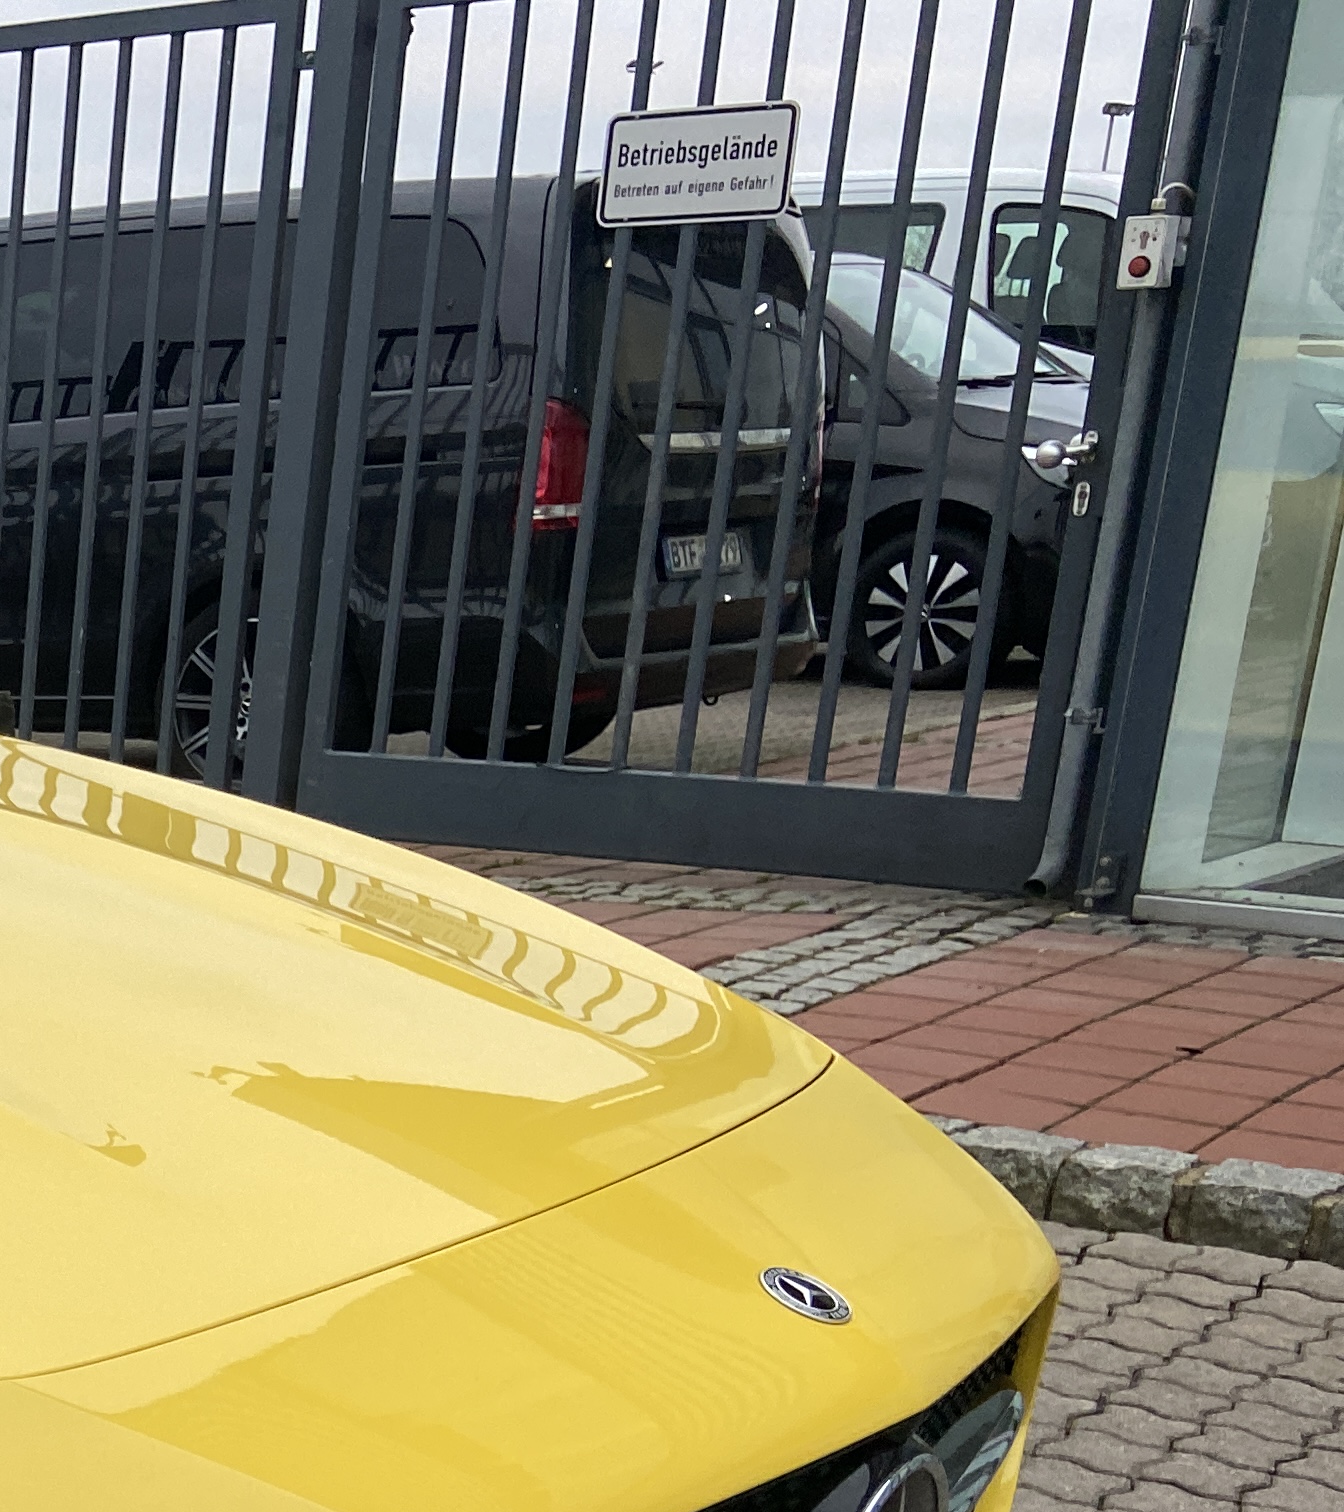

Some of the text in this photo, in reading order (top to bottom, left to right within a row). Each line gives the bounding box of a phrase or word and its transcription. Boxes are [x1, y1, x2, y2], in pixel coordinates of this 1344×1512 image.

[617, 133, 778, 169] Betriebsgelände
[614, 183, 660, 198] Betreten
[664, 180, 683, 195] auf
[687, 179, 725, 197] eigene
